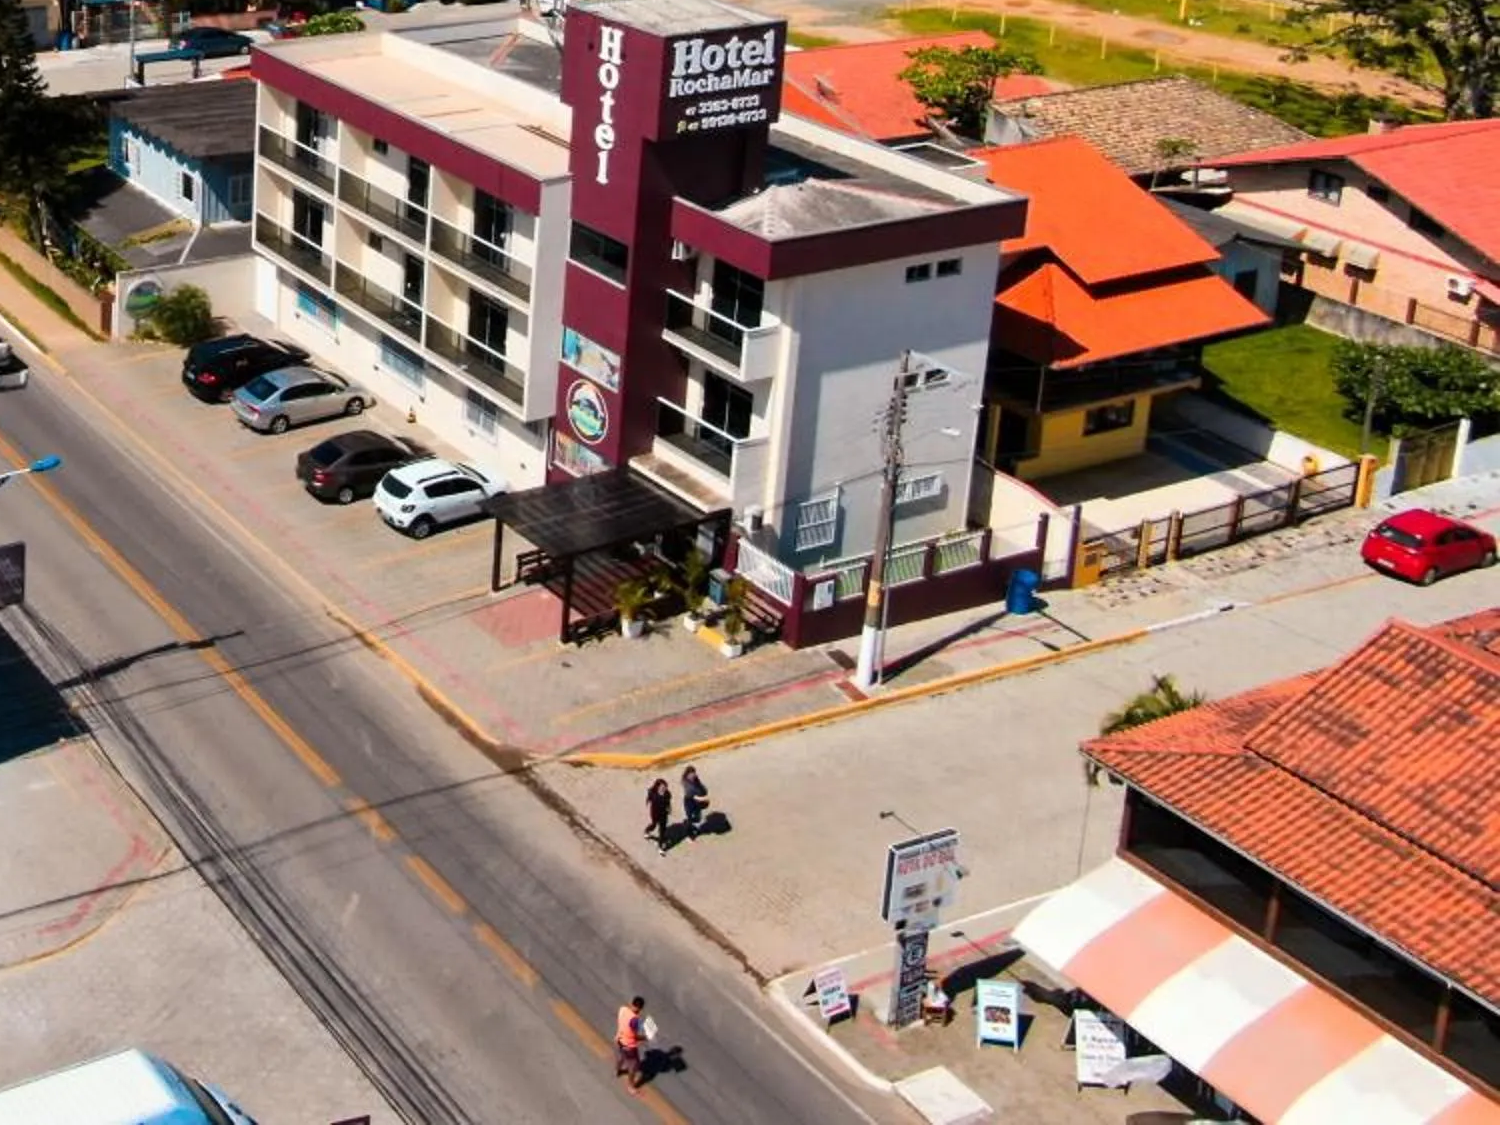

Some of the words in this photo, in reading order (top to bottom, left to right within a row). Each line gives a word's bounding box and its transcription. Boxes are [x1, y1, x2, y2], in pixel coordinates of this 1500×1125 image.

[671, 29, 775, 77] Hotel
[594, 26, 624, 184] Hotel
[669, 68, 774, 98] RochaMar
